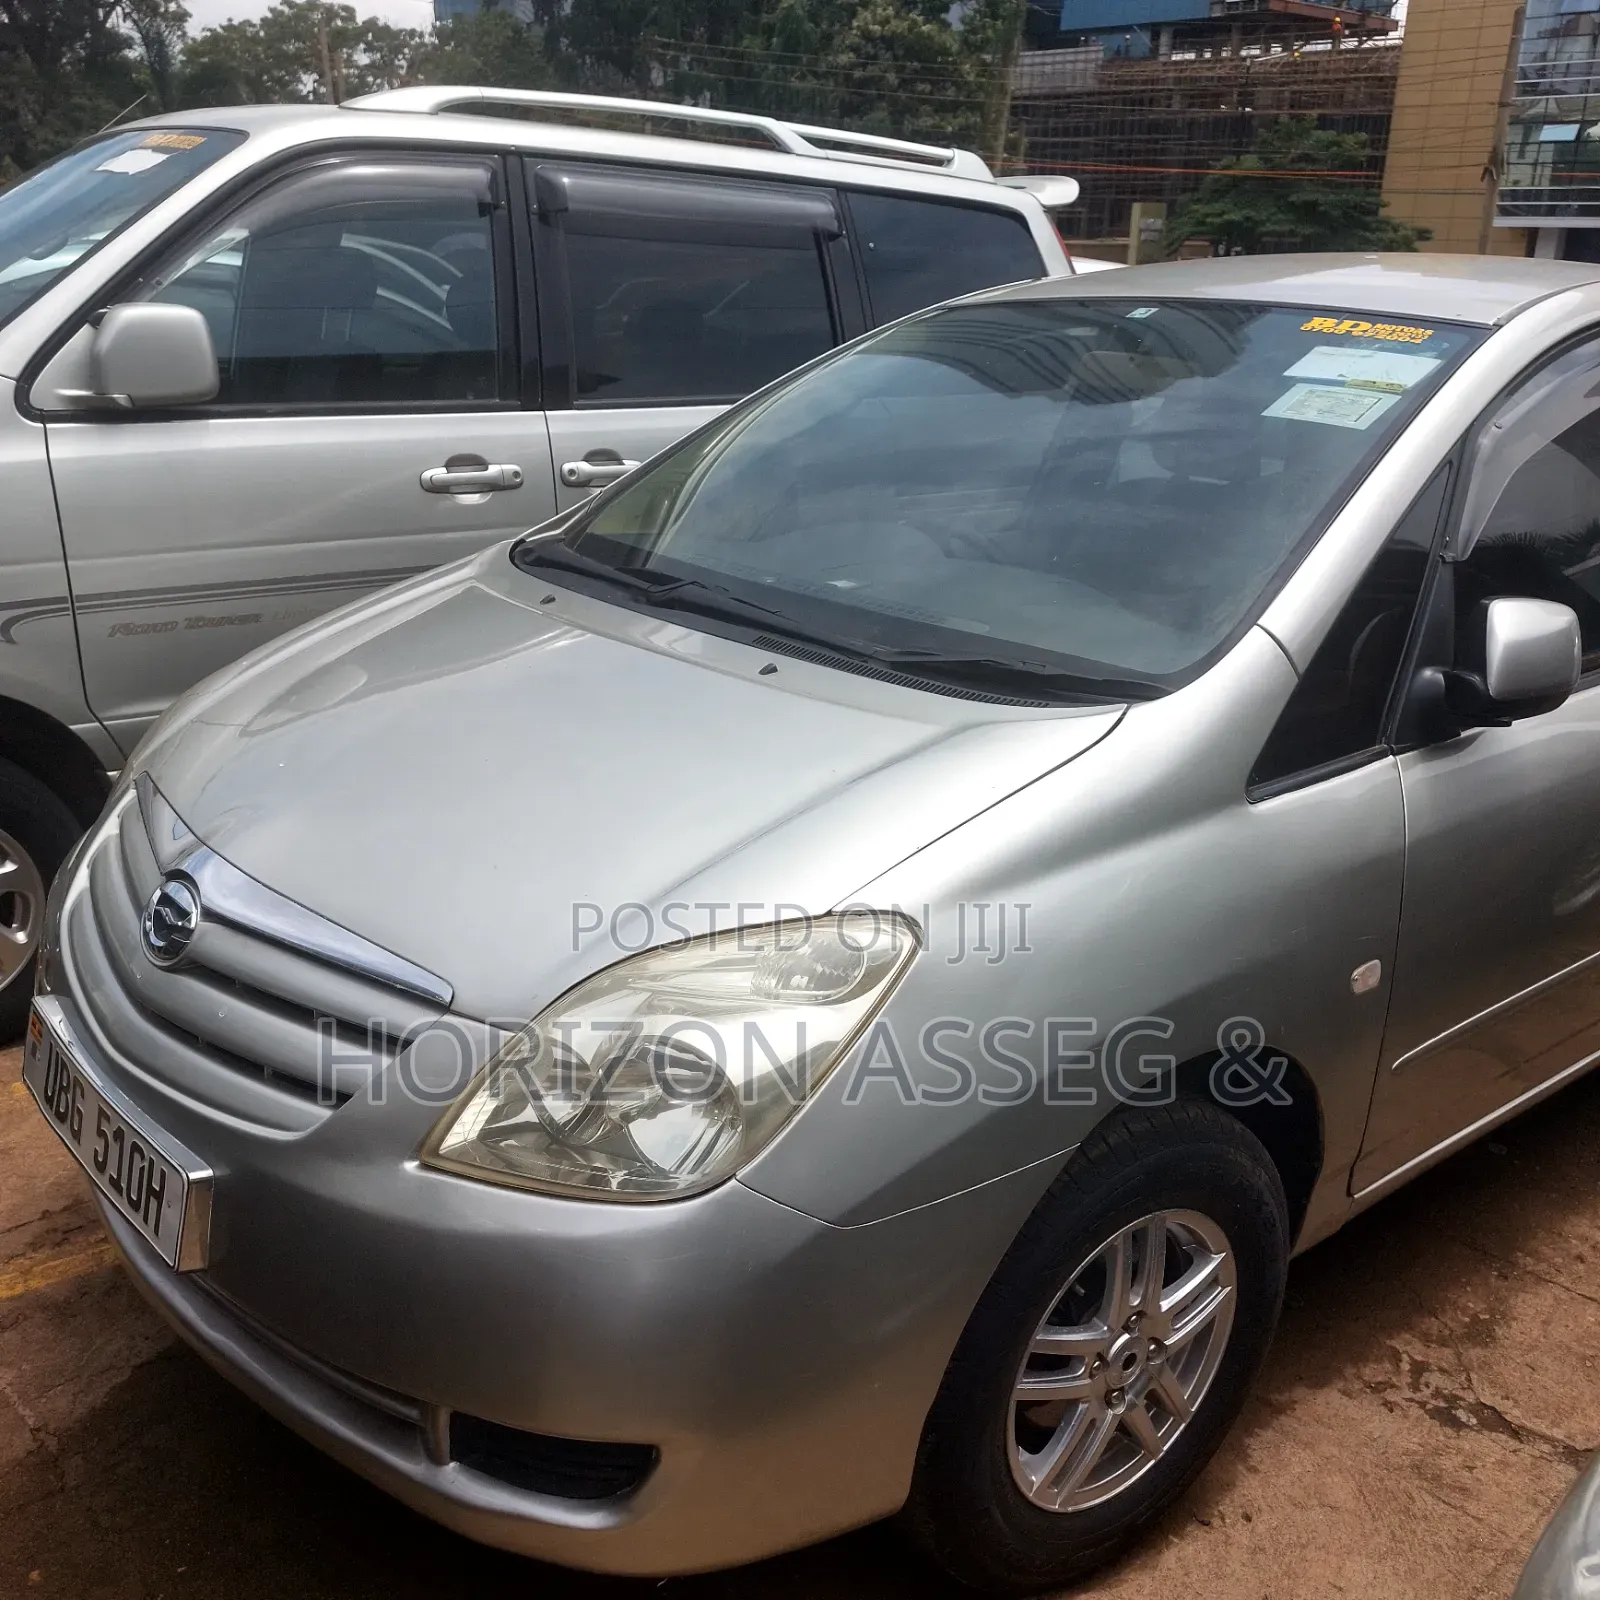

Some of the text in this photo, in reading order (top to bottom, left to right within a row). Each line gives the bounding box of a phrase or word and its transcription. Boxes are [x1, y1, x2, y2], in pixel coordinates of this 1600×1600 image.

[1373, 323, 1434, 335] MOTORS
[43, 1041, 166, 1237] UBG 510H
